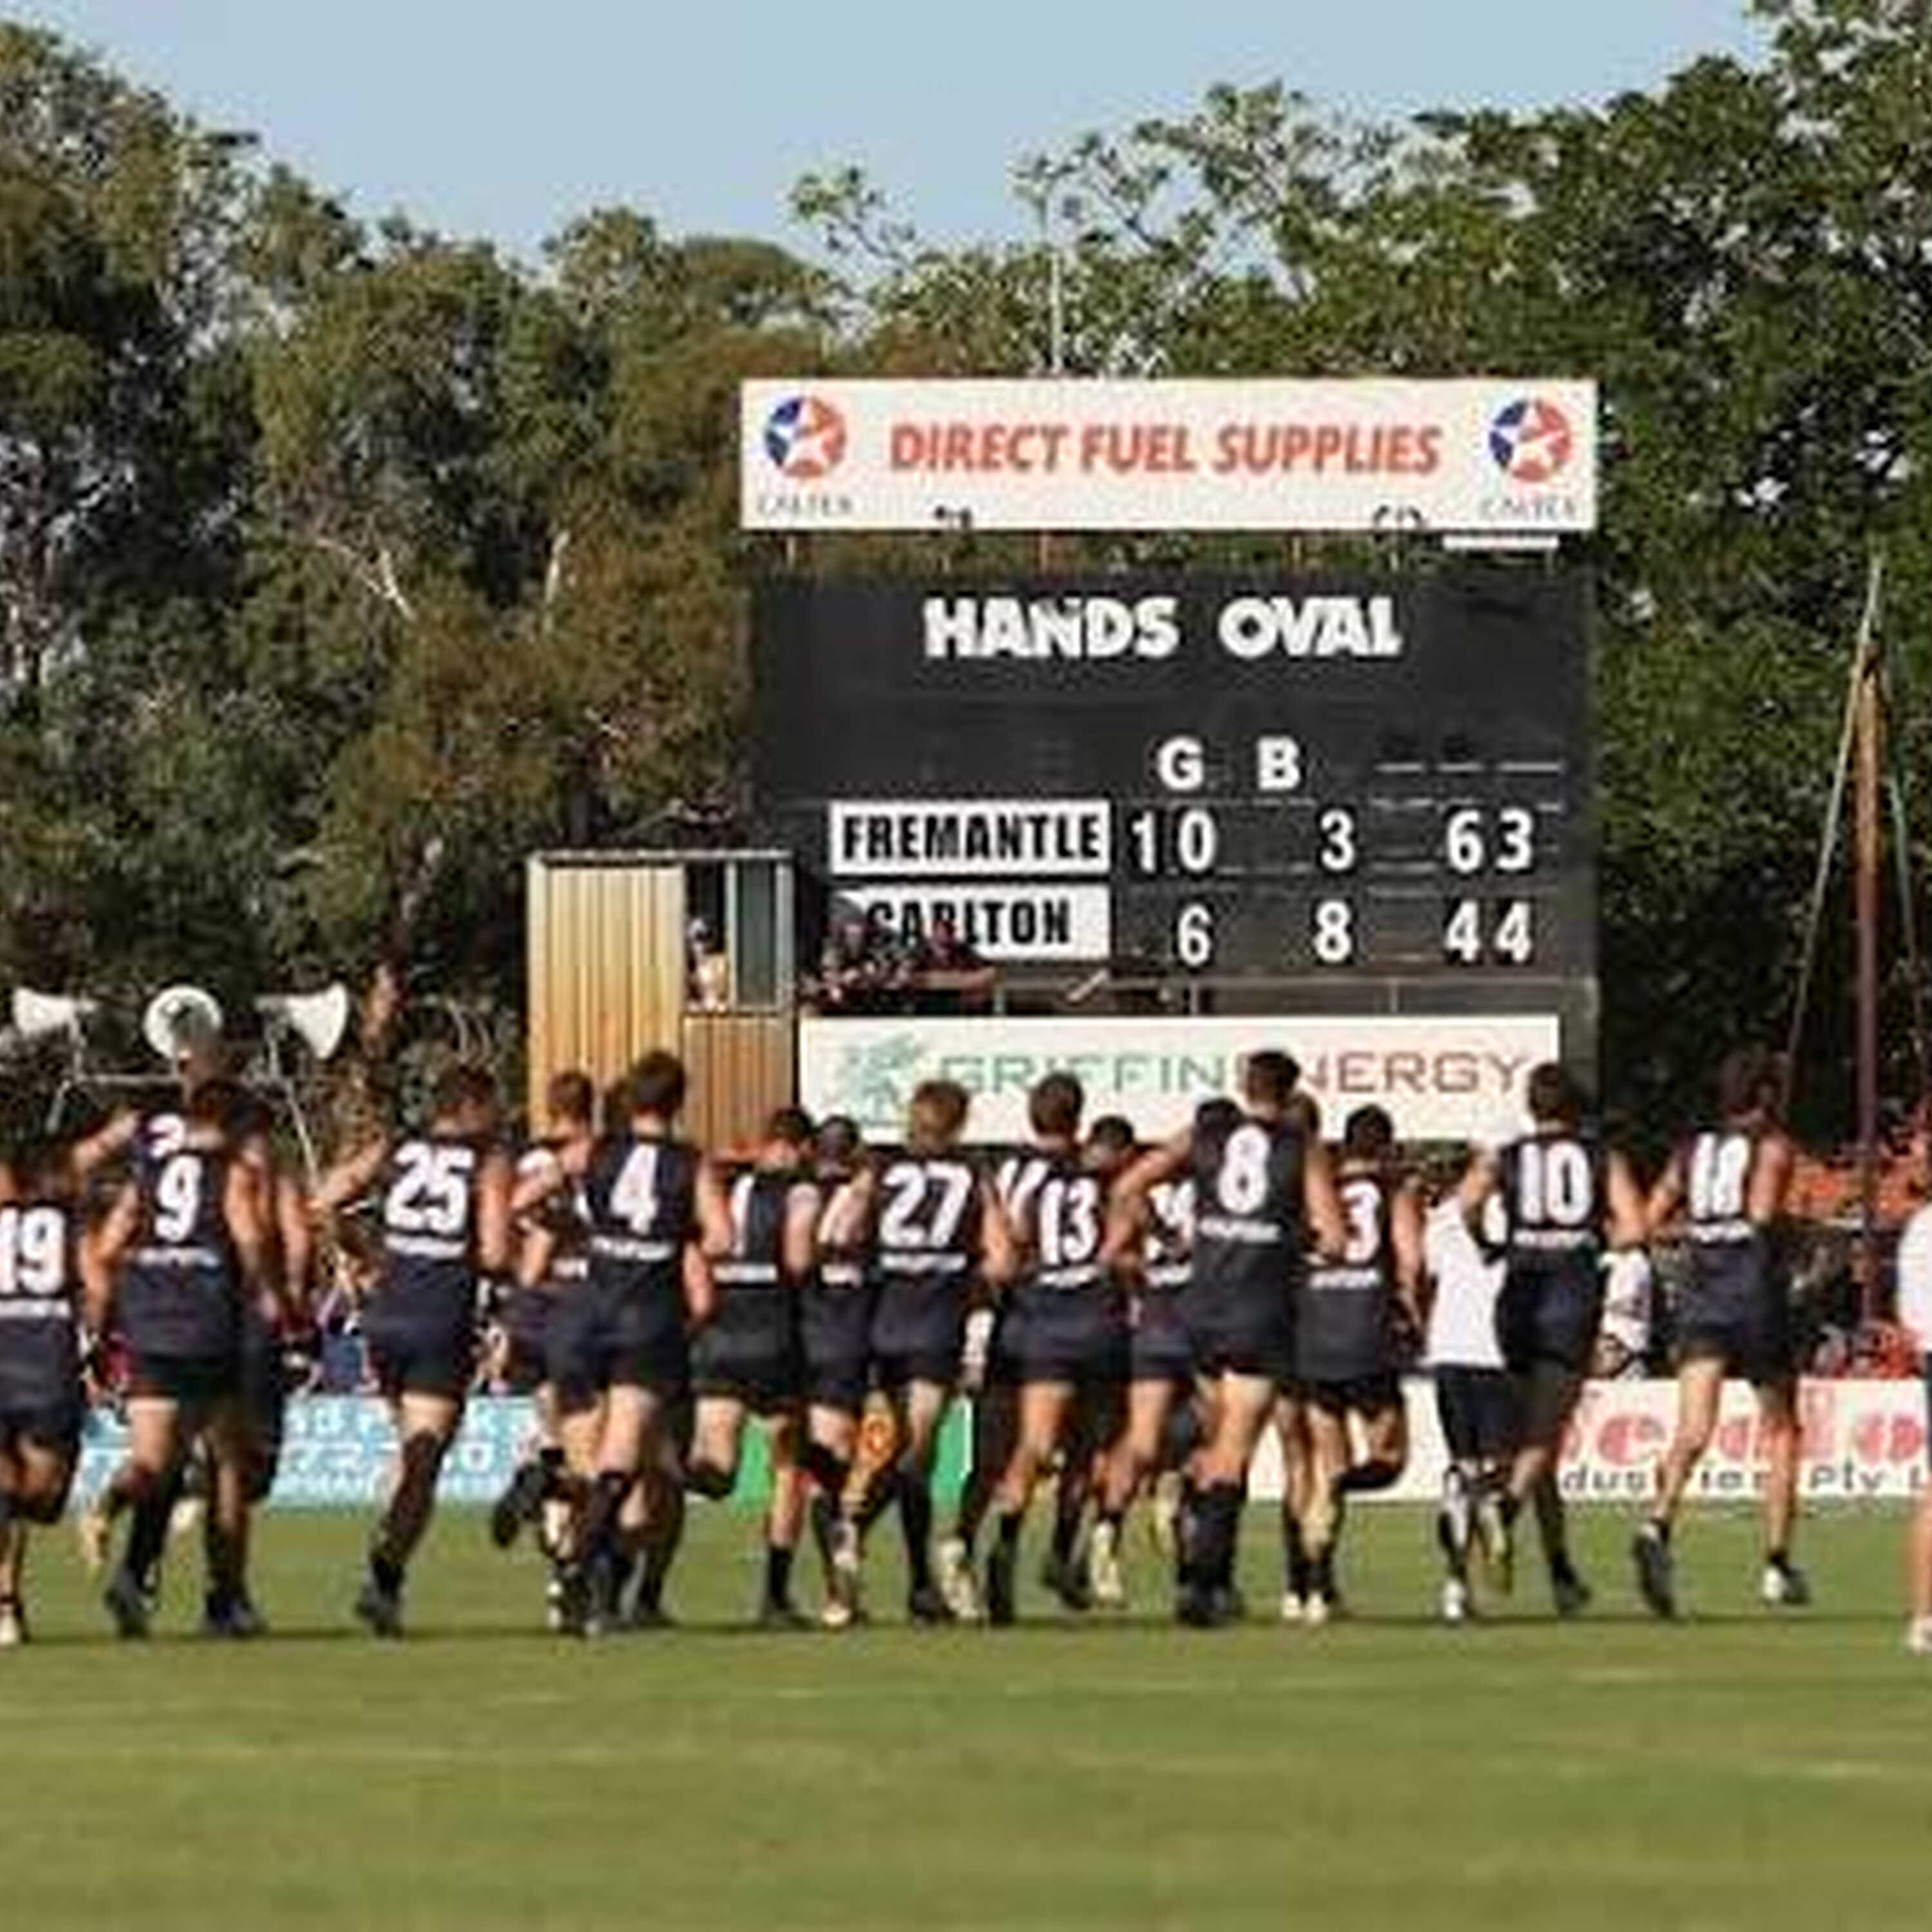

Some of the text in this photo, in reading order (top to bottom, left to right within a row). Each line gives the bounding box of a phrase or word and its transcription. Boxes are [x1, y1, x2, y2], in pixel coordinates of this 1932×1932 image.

[889, 422, 1443, 477] DIRECT FUEL SUPPLIES
[923, 596, 1402, 658] HANDS OVAL
[1158, 737, 1301, 790] G B
[843, 808, 1533, 872] FREMANTLE 10 3 63
[1179, 904, 1211, 965] 6
[1313, 900, 1351, 962] 8
[1444, 901, 1532, 962] 44
[154, 1155, 201, 1242] 9
[386, 1142, 473, 1233] 25
[611, 1144, 657, 1233] 4
[880, 1162, 972, 1247] 27
[1218, 1125, 1269, 1214] 8
[1520, 1141, 1592, 1223] 10
[0, 1208, 65, 1294] 19
[1039, 1177, 1097, 1265] 13
[1342, 1182, 1380, 1261] 3
